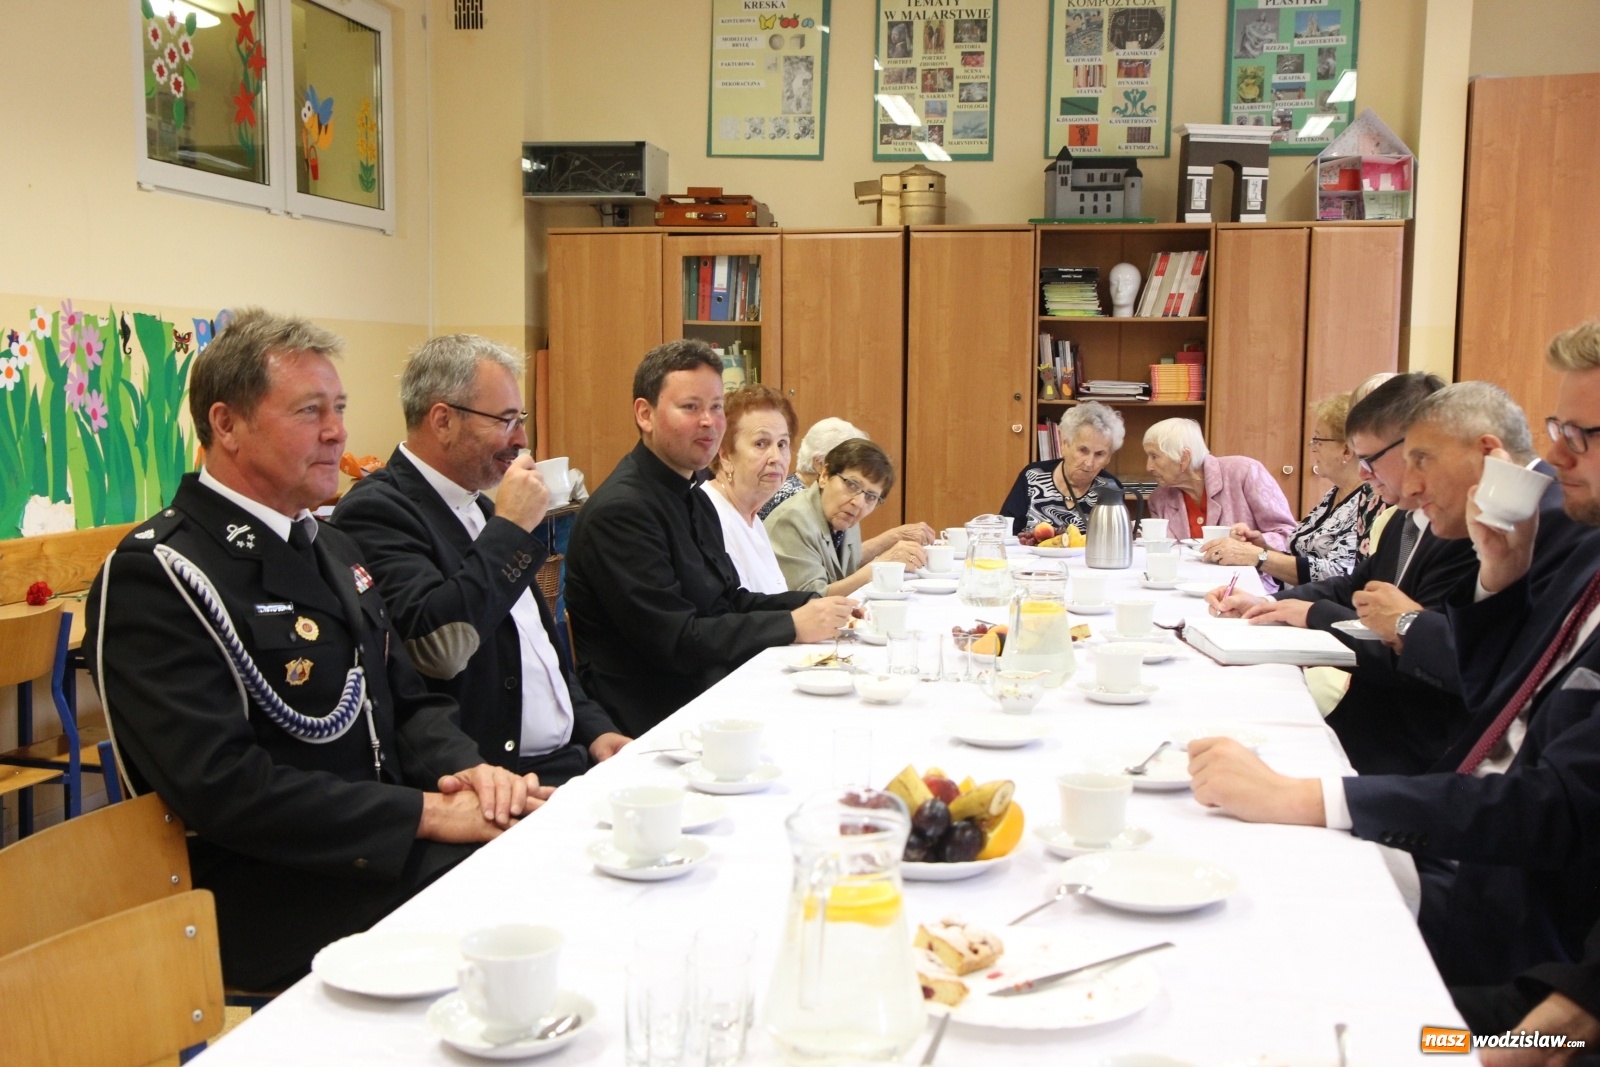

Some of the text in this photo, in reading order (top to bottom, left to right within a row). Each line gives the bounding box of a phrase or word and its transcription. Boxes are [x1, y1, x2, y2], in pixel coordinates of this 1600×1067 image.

[744, 1, 786, 9] KRESKA
[1067, 0, 1157, 8] KOMPOZYCJA
[884, 9, 991, 20] W MALARSTWIE
